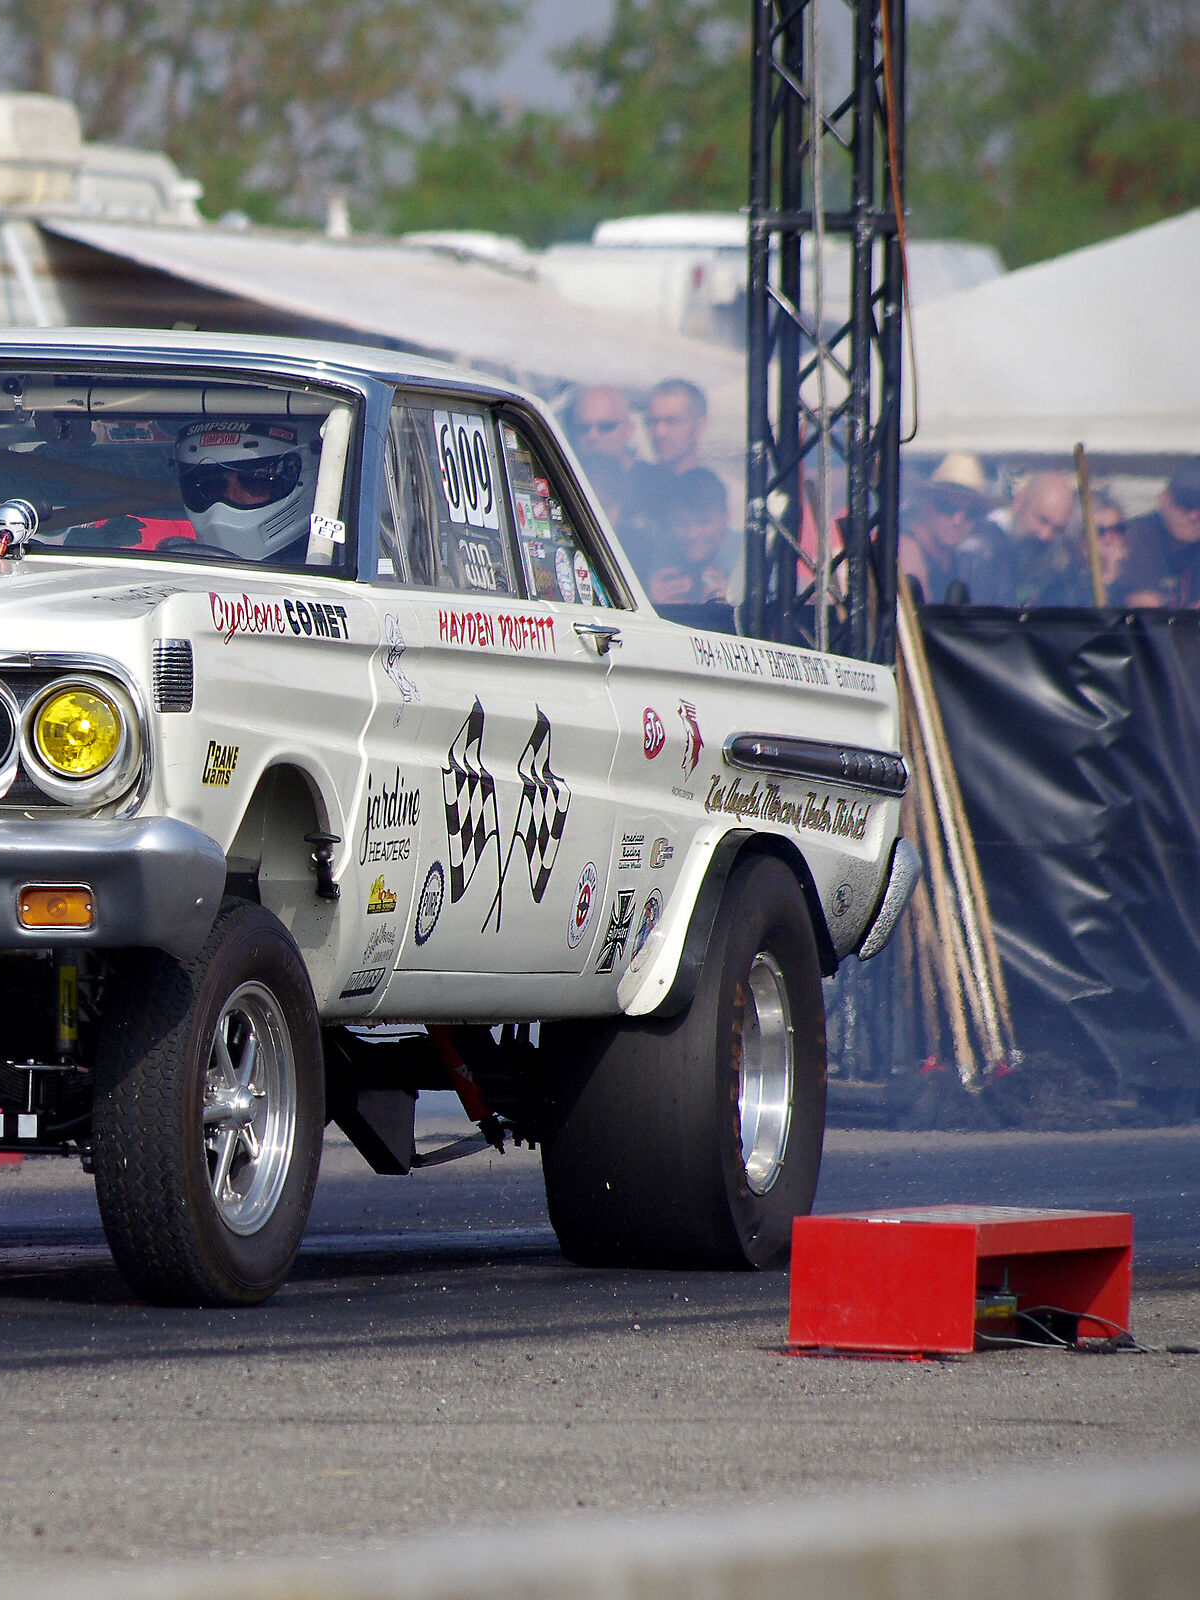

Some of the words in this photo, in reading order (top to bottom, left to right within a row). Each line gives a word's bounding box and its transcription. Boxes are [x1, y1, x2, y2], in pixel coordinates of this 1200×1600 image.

[187, 422, 250, 436] SIMPSON
[202, 433, 238, 446] SIMPSON
[440, 424, 492, 514] 609
[313, 515, 343, 531] Pro
[317, 527, 339, 539] ET
[208, 592, 286, 645] Cyclone
[284, 599, 350, 640] COMET
[438, 609, 495, 647] HAYDEN
[690, 636, 716, 667] 1964
[645, 711, 663, 752] STP
[204, 740, 240, 770] CRANE
[359, 766, 421, 866] jardine
[368, 838, 410, 863] HEADERS
[421, 891, 440, 917] PURE
